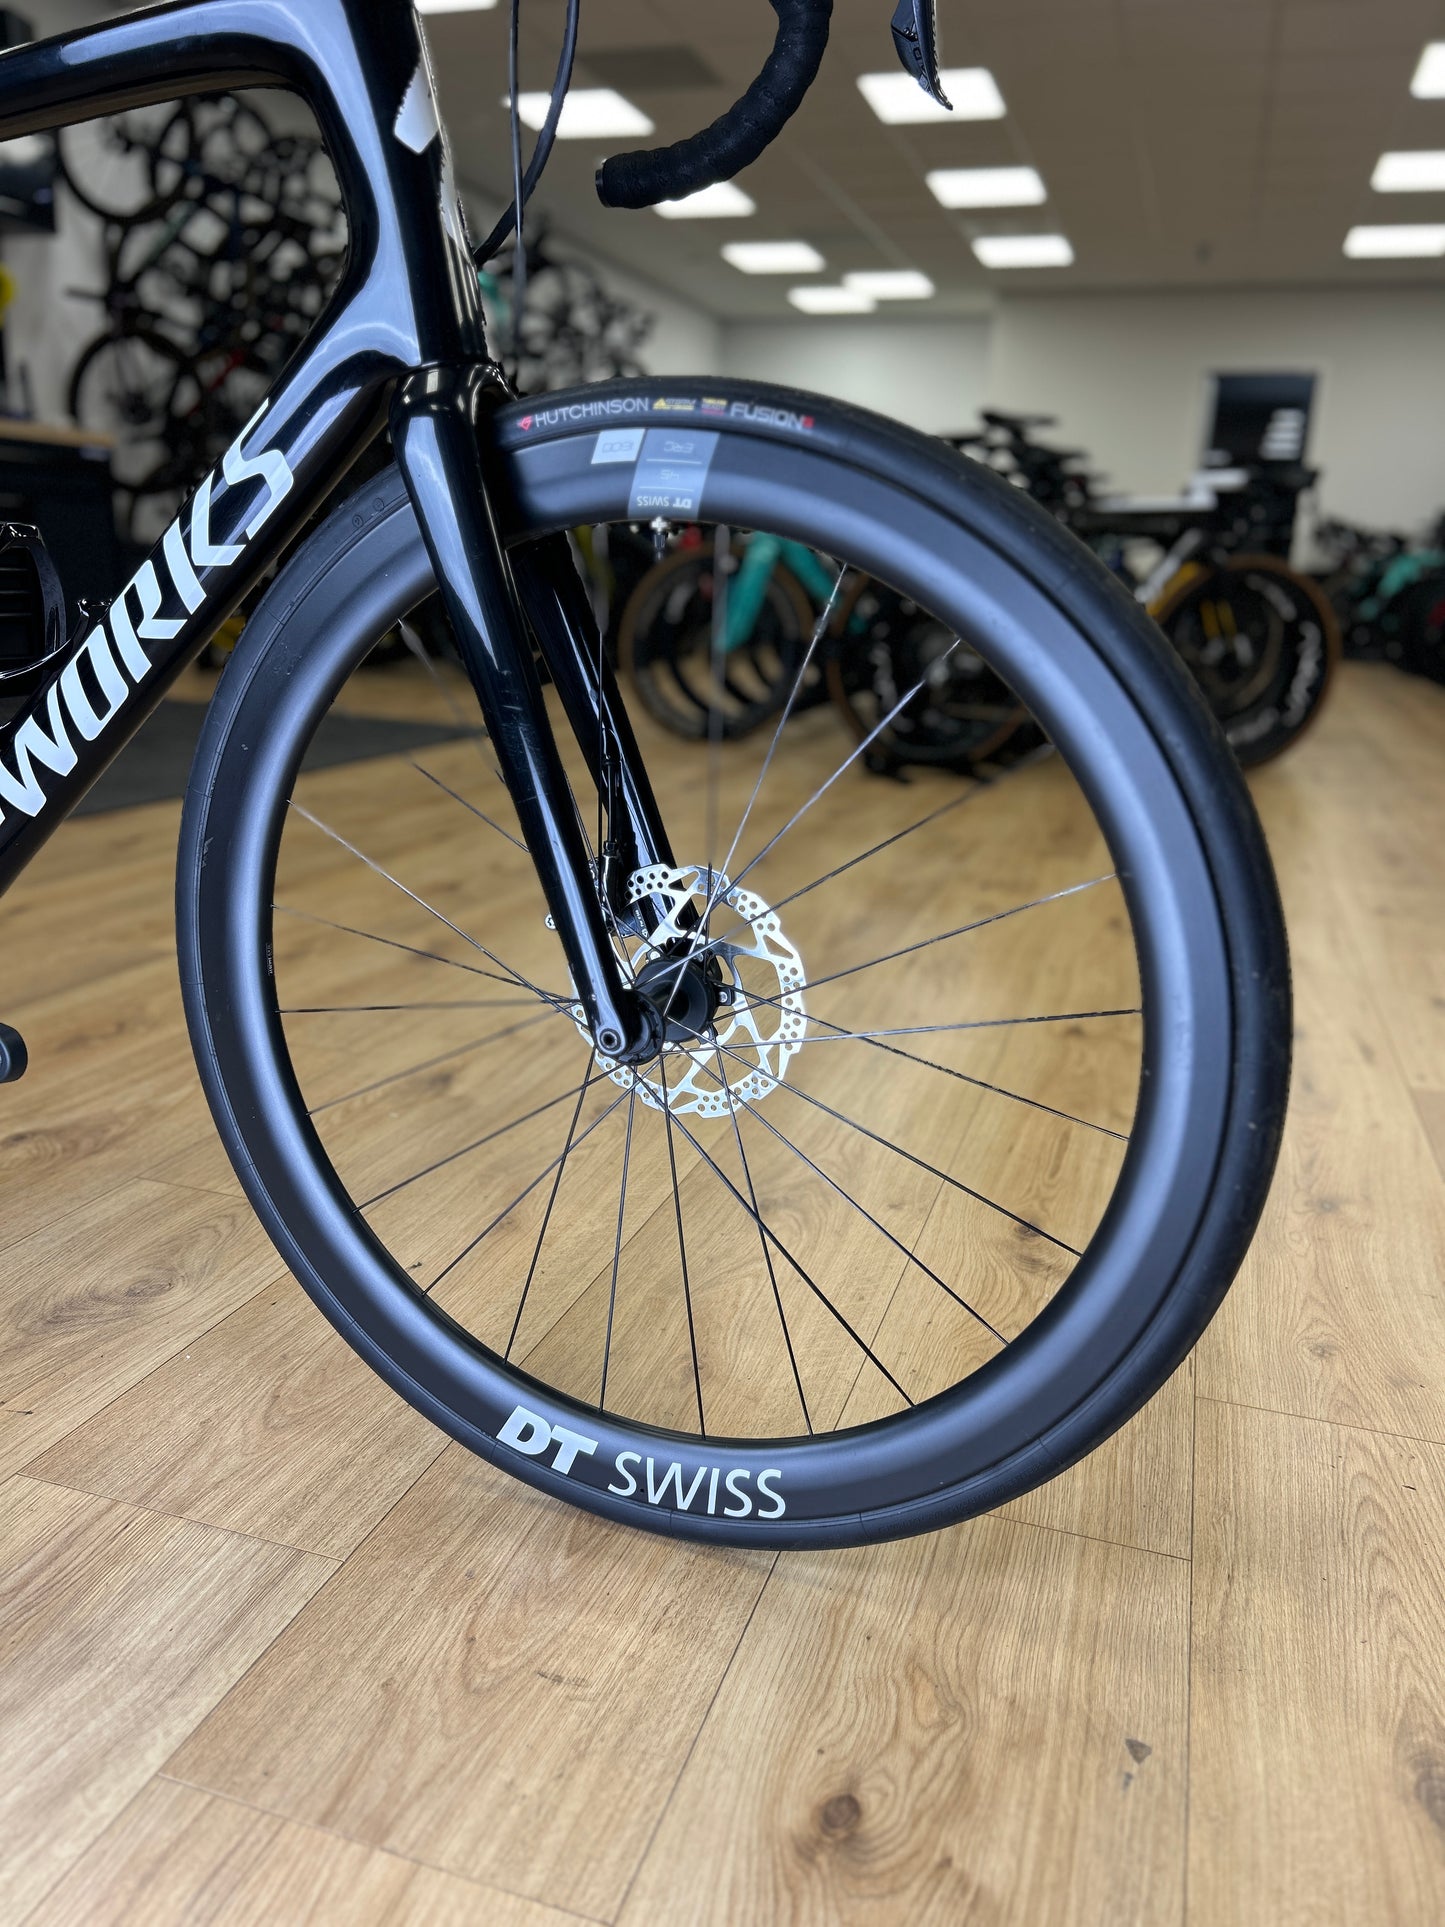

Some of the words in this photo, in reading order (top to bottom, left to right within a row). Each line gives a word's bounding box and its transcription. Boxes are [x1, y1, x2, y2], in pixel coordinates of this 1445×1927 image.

[535, 397, 649, 427] HUTCHINSON
[730, 401, 804, 431] FUSION
[636, 496, 670, 507] SWISS
[672, 497, 692, 509] DT
[496, 1405, 598, 1475] DT
[607, 1451, 786, 1519] SWISS
